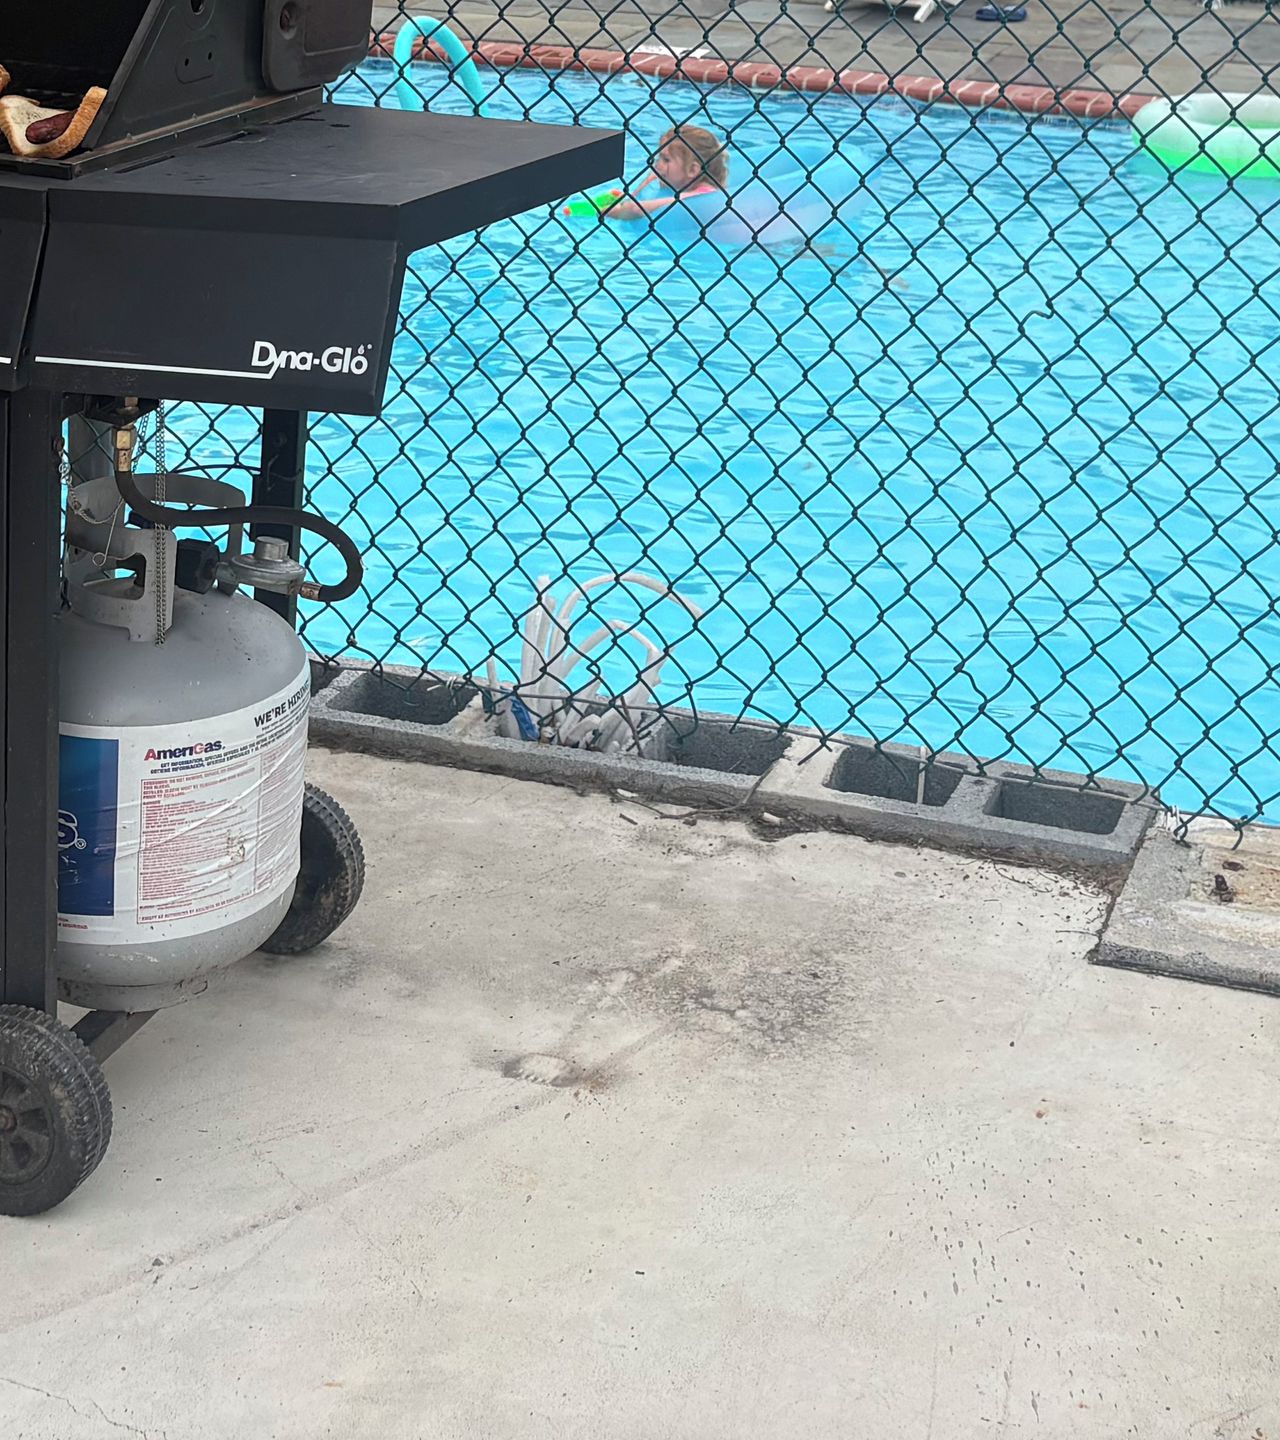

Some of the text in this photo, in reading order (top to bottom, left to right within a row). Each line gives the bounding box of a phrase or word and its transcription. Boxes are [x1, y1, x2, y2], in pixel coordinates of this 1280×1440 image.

[251, 340, 368, 376] Dyna-Glo
[254, 701, 286, 727] WE'RE
[144, 740, 222, 760] AmeriGas
